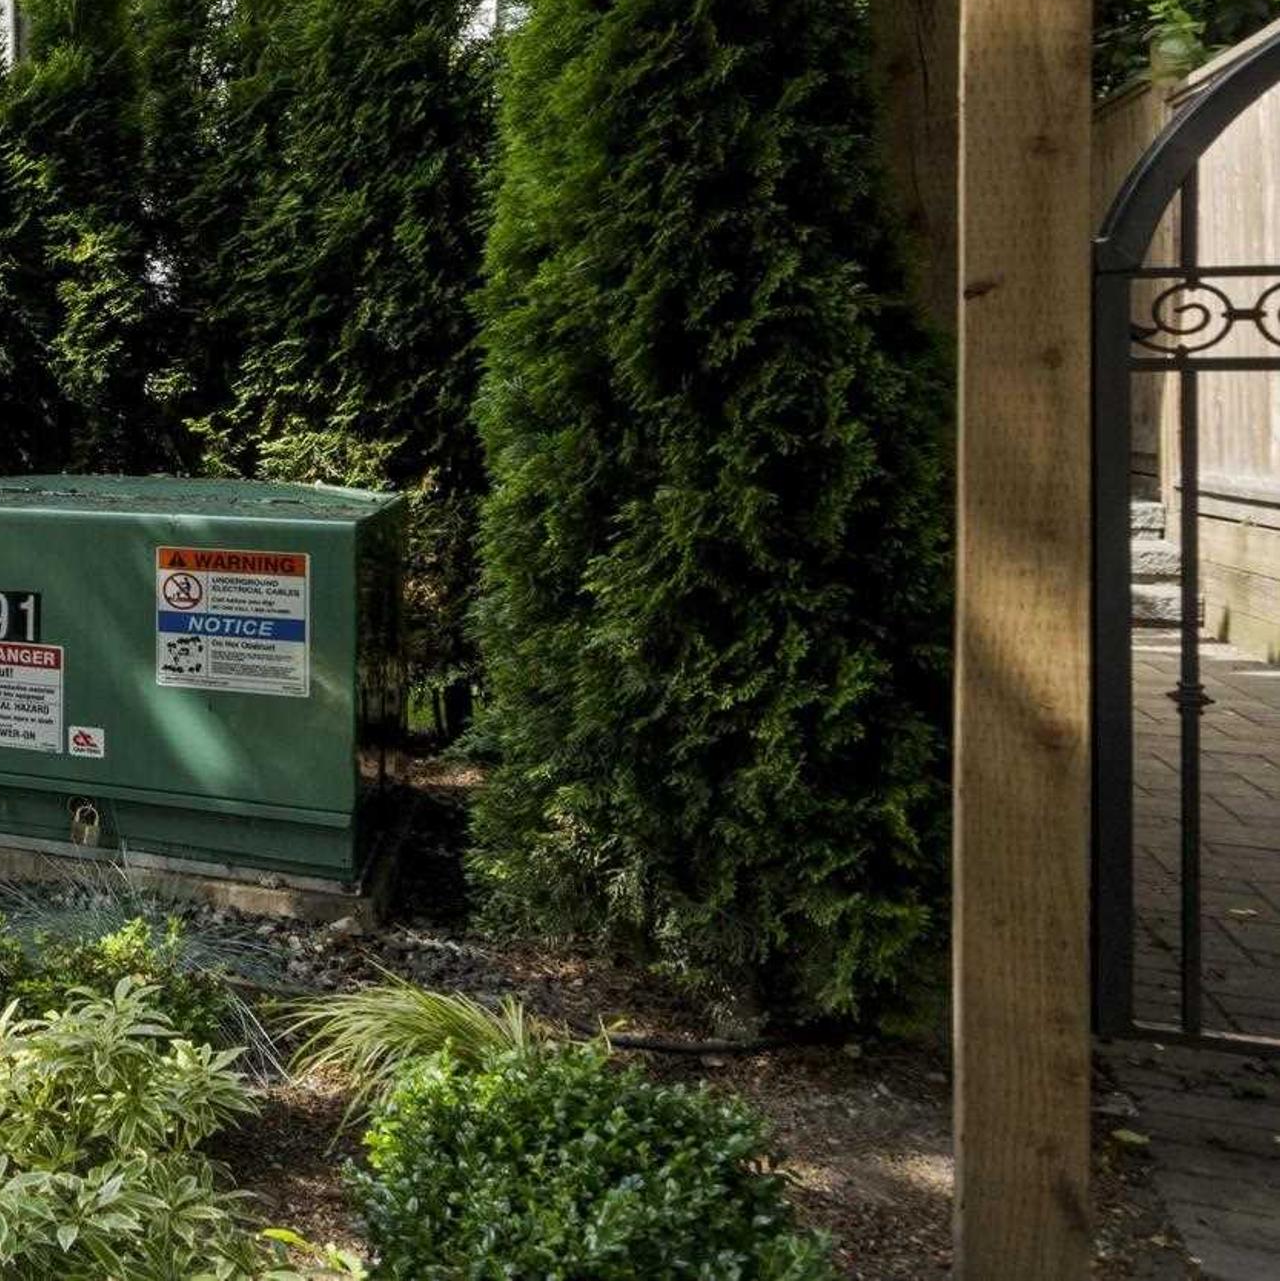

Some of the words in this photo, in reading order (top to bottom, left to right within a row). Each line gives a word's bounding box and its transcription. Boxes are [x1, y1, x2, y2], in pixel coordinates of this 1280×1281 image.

[194, 552, 294, 573] WARNING
[211, 577, 279, 588] UNDERGROUND
[211, 585, 263, 596] ELECTRICAL
[265, 588, 300, 598] CABLES
[188, 616, 274, 637] NOTICE
[14, 700, 49, 715] HAZARD
